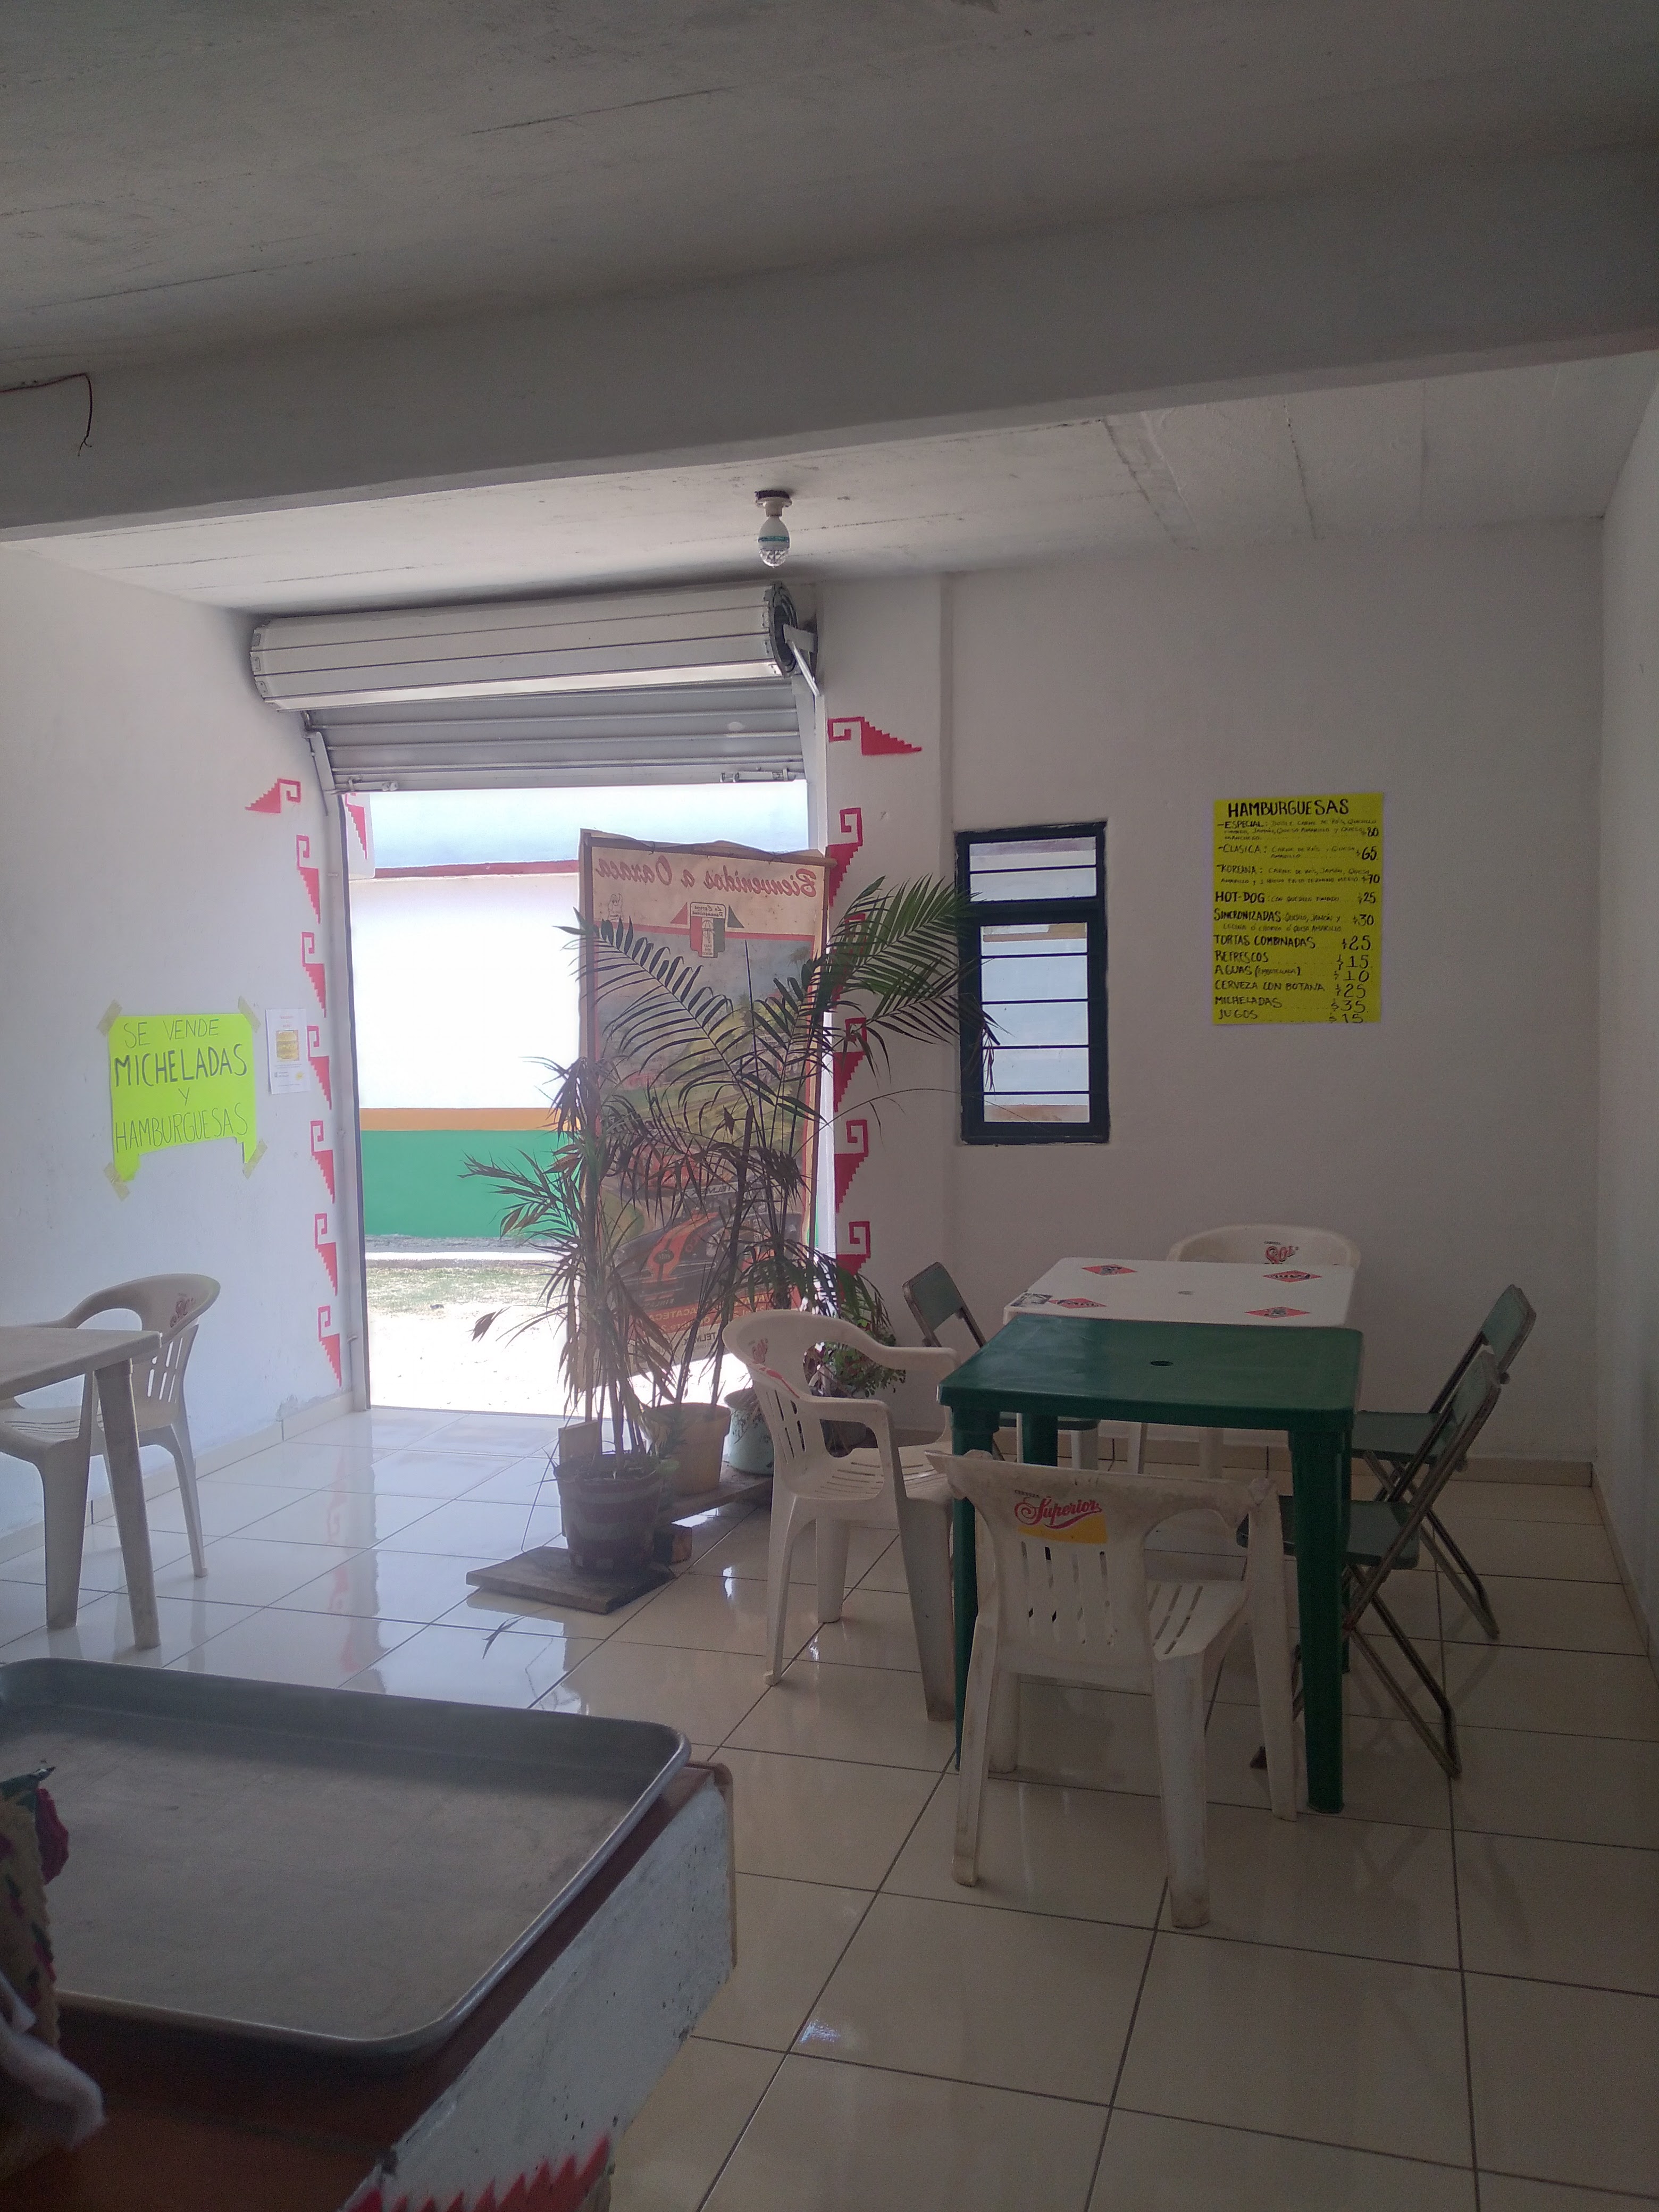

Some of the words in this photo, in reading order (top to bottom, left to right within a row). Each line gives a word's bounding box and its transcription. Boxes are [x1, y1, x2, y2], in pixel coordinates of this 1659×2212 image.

[1228, 799, 1350, 818] HAMBURGUESAS
[1213, 934, 1250, 947] TORTAS
[1254, 935, 1316, 949] COMBINADAS
[1214, 949, 1269, 964] REFRESCOS
[1214, 965, 1253, 976] AGUAS
[1214, 979, 1259, 991] CERVEZA
[1262, 981, 1282, 991] CON
[1285, 982, 1326, 992] BOTANA
[1214, 996, 1283, 1009] MICHELADAS
[1218, 1009, 1258, 1020] JUGOS
[123, 1021, 150, 1049] SE
[163, 1018, 219, 1041] VENDE
[114, 1043, 247, 1087] MICHELADAS
[178, 1087, 190, 1106] Y
[115, 1102, 248, 1153] HAMBURGUESAS
[1014, 1496, 1102, 1529] Superior
